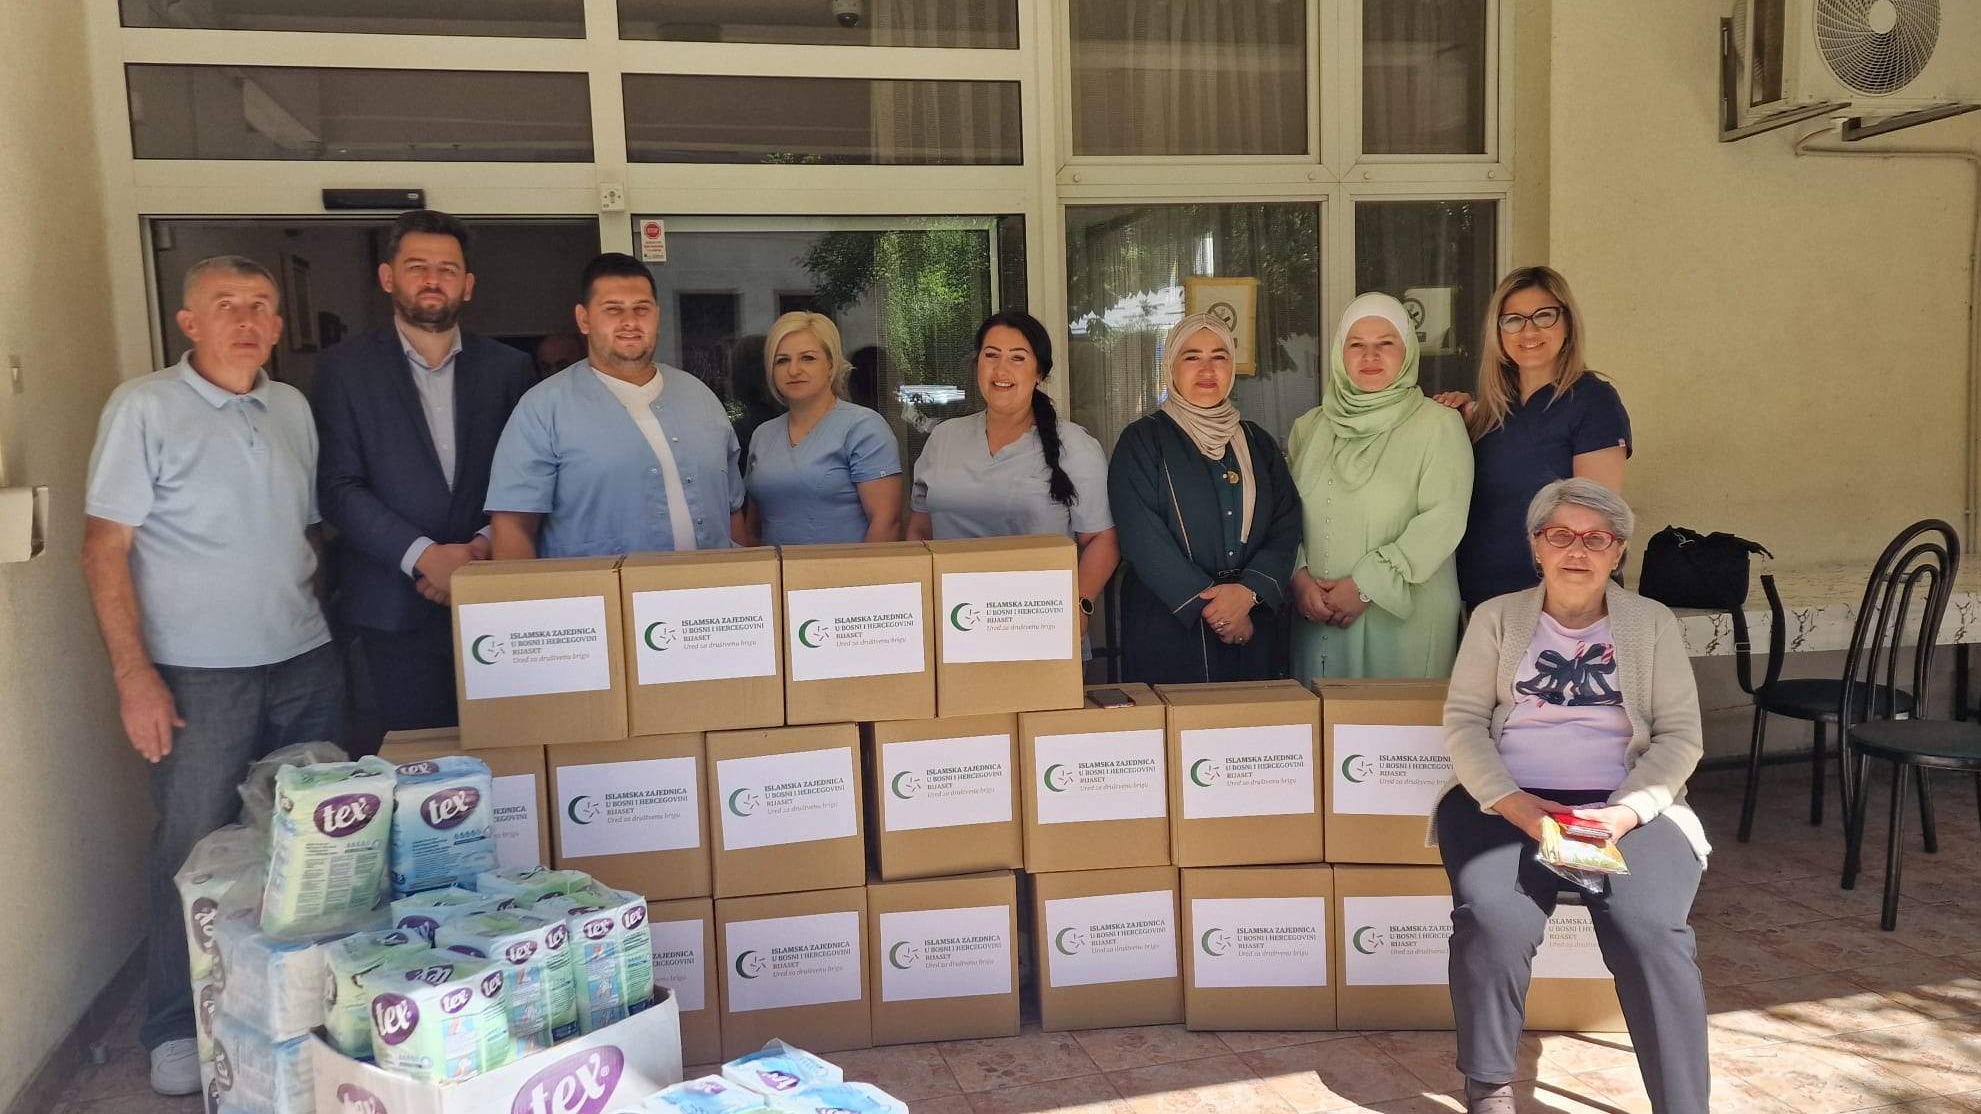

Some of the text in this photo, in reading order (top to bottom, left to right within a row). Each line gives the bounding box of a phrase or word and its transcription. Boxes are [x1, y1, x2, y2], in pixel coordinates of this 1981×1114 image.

[1024, 599, 1063, 607] ZAJEDNICA
[1018, 607, 1063, 615] HERCEGOVINI
[682, 615, 763, 627] ISLAMSKA ZAJEDNICA
[835, 612, 913, 624] ISLAMSKA ZAJEDNICA
[867, 620, 914, 629] HERCEGOVINI
[510, 627, 596, 640] ISLAMSKA ZAJEDNICA
[689, 626, 710, 634] BOSNI
[716, 623, 764, 632] HERCEGOVINI
[518, 639, 541, 647] BOSNI
[546, 635, 597, 645] HERCEGOVINI
[683, 634, 711, 642] RIJASET
[1079, 758, 1155, 769] ISLAMSKA ZAJEDNICA
[1226, 753, 1303, 764] ISLAMSKA ZAJEDNICA
[926, 763, 1001, 776] ISLAMSKA ZAJEDNICA
[1110, 766, 1155, 774] HERCEGOVINI
[1258, 761, 1304, 770] HERCEGOVINI
[958, 770, 1002, 780] HERCEGOVINI
[764, 777, 844, 792] ISLAMSKA ZAJEDNICA
[605, 787, 687, 800] ISLAMSKA ZAJEDNICA
[772, 790, 793, 799] BOSNI
[798, 785, 845, 796] HERCEGOVINI
[639, 795, 688, 805] HERCEGOVINI
[322, 797, 367, 832] tex
[428, 791, 469, 825] tex
[624, 908, 643, 928] tex
[586, 920, 609, 937] tex
[1090, 919, 1165, 932] ISLAMSKA ZAJEDNICA
[547, 927, 567, 948] tex
[924, 935, 1001, 946] ISLAMSKA ZAJEDNICA
[1096, 931, 1116, 939] BOSNI
[510, 943, 533, 962] tex
[772, 941, 850, 955] ISLAMSKA ZAJEDNICA
[778, 953, 799, 962] BOSNI
[804, 948, 850, 959] HERCEGOVINI
[483, 972, 502, 996] tex
[442, 989, 468, 1013] tex
[375, 1000, 410, 1036] tex
